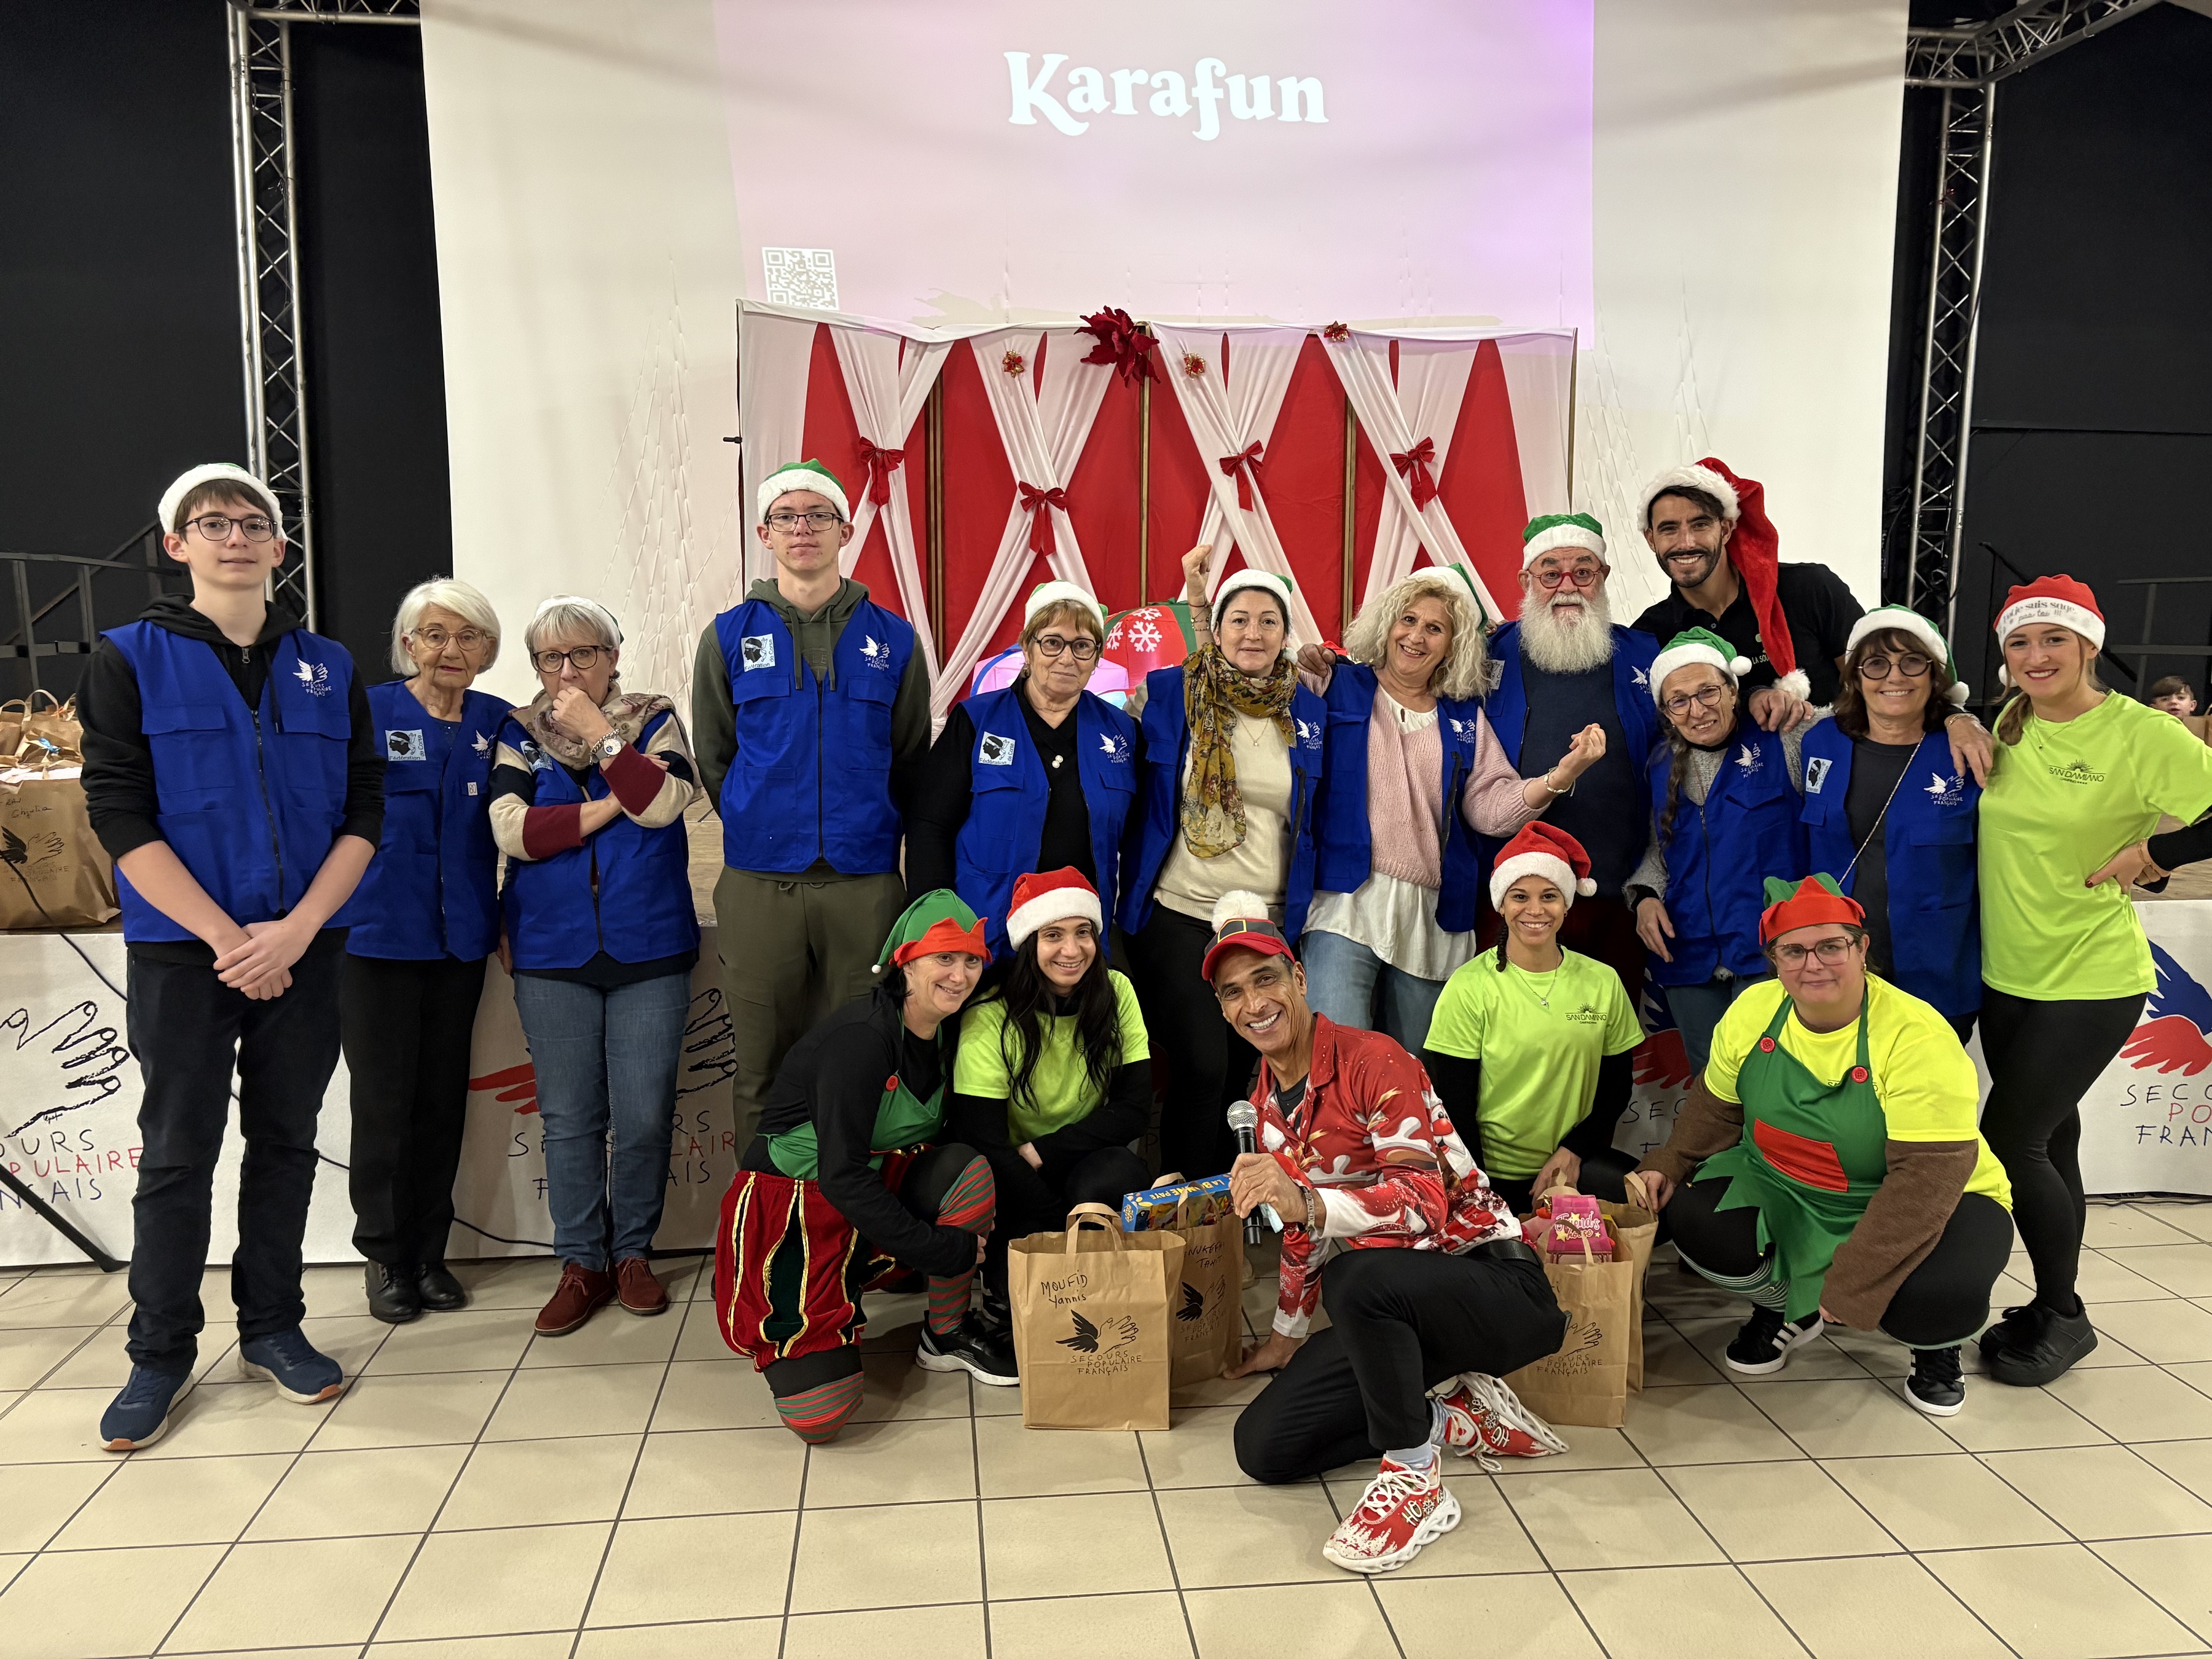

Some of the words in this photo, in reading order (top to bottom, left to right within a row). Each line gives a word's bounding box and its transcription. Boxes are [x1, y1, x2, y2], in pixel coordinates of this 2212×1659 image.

[1003, 52, 1329, 141] Karafun
[2025, 600, 2047, 609] suis
[2049, 767, 2065, 776] SAN
[2168, 1102, 2212, 1124] PO
[0, 1129, 94, 1158] URS
[1149, 1191, 1172, 1200] PAYE
[1070, 1350, 1128, 1363] SECOURS
[1087, 1355, 1142, 1368] POPULAIRE
[1547, 1359, 1603, 1368] POPULAIRE
[1077, 1365, 1128, 1376] FRANÇAIS
[1536, 1366, 1588, 1376] FRANÇAIS
[1402, 1500, 1422, 1526] HO
